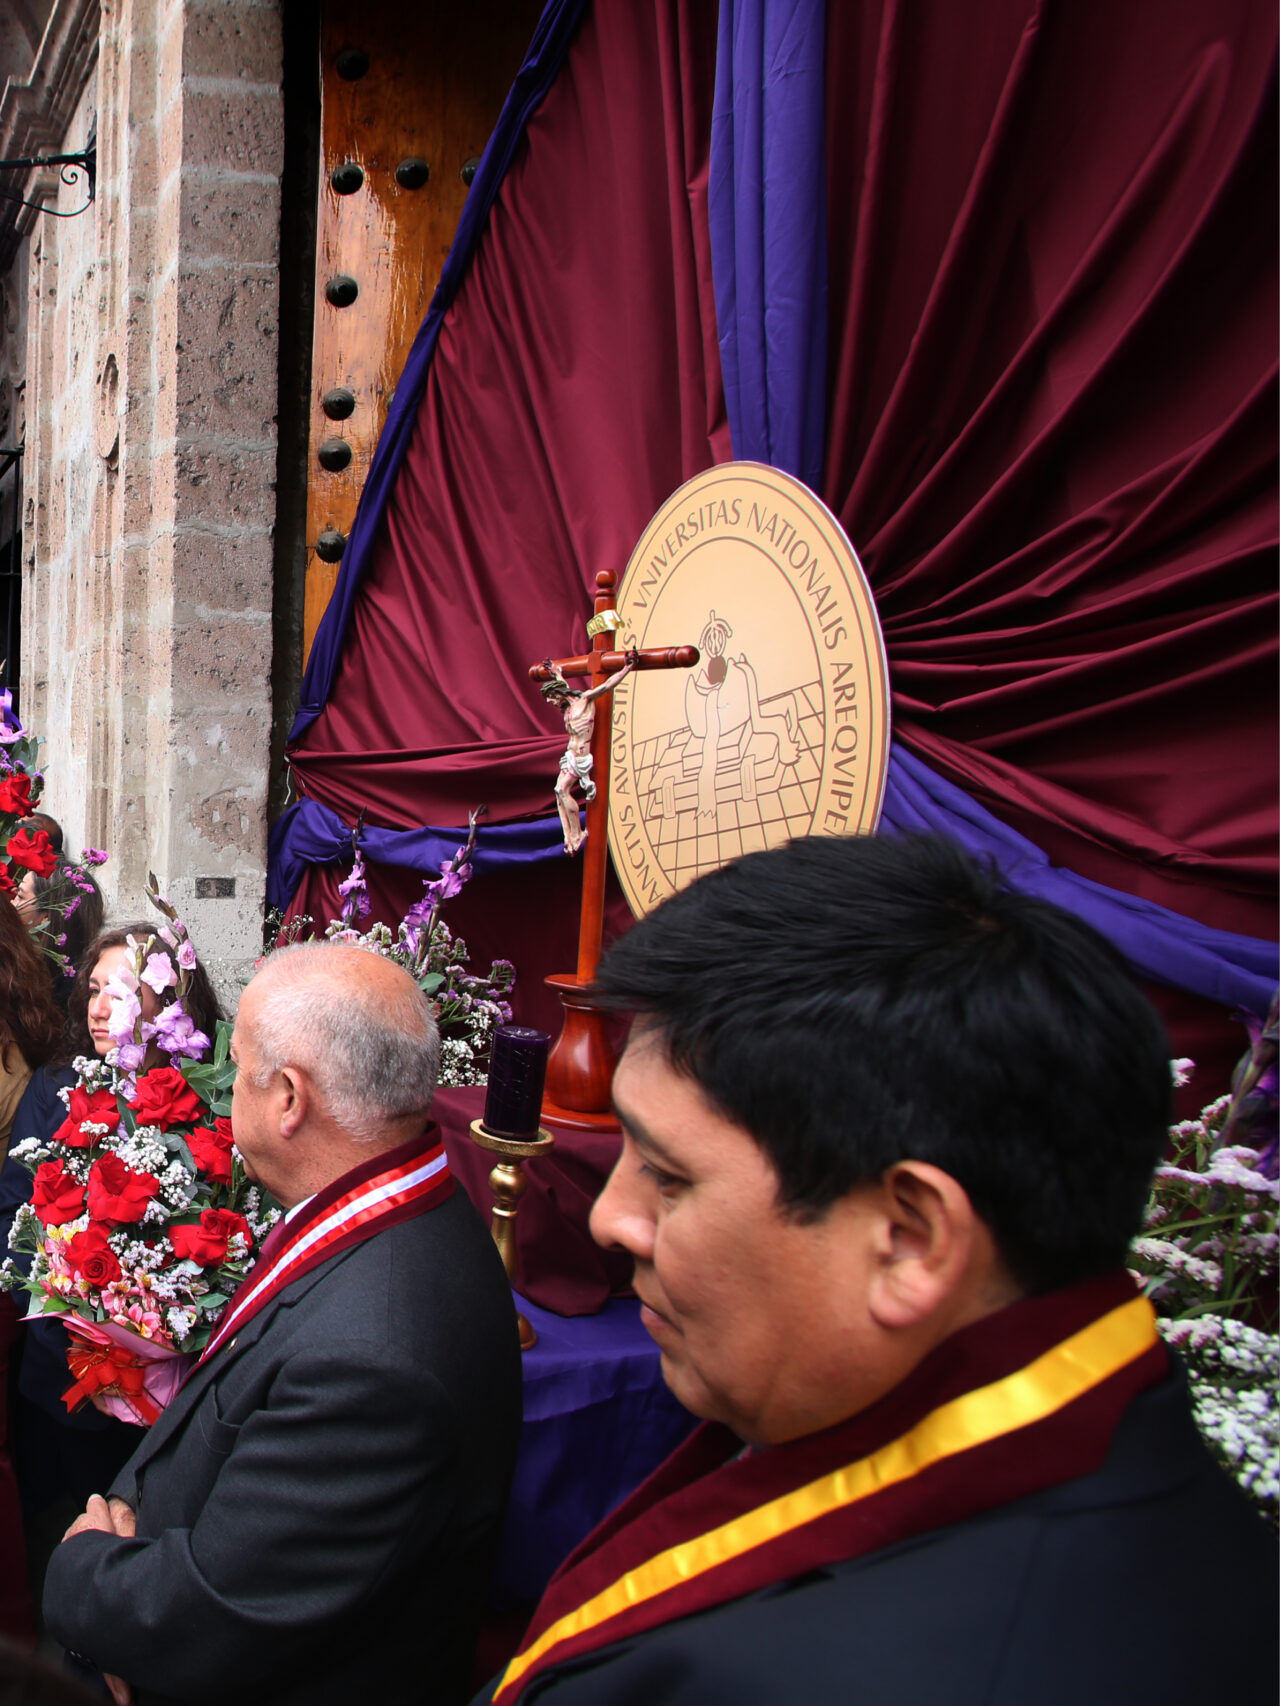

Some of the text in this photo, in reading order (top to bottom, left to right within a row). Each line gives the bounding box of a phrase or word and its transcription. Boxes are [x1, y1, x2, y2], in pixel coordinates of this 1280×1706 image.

[633, 498, 858, 837] VNIVERSITAS NATIONALIS AREQVIPE
[619, 805, 665, 905] ANCTVS
